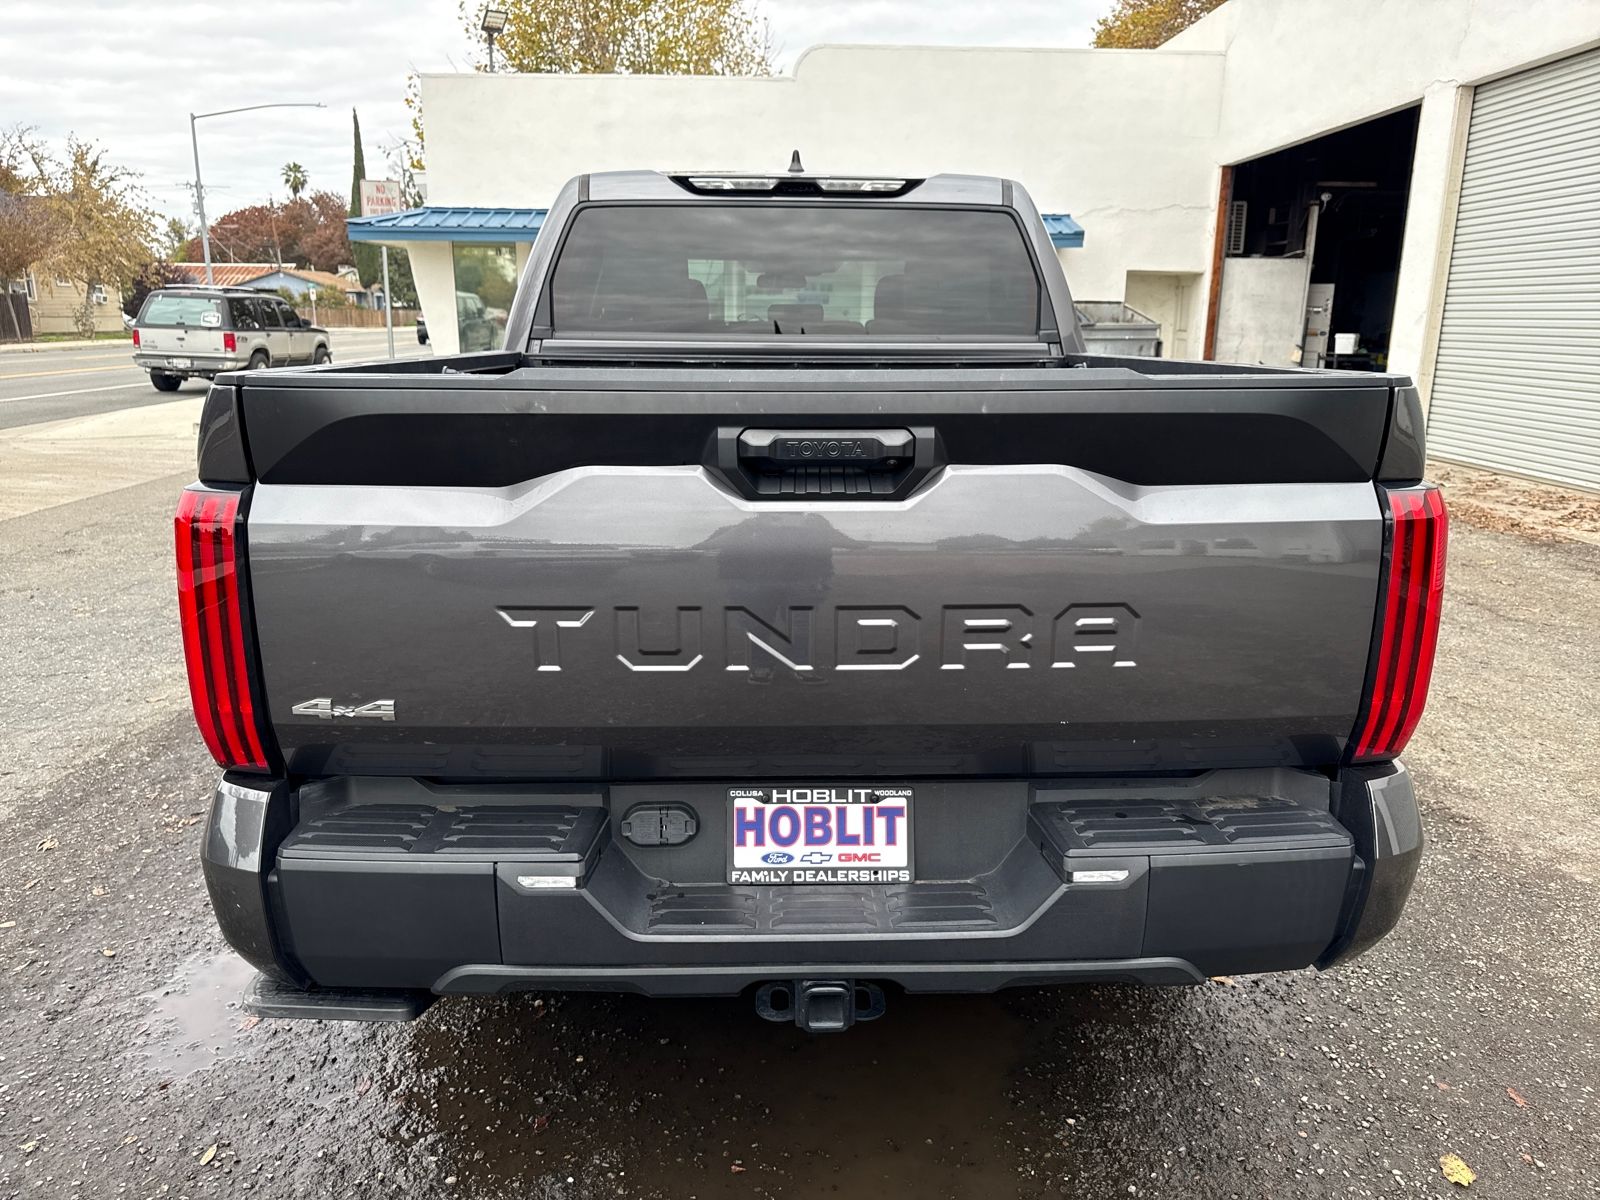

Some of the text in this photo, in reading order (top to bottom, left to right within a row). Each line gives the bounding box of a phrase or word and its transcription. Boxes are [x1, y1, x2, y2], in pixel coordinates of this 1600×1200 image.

[375, 183, 386, 194] NO
[786, 441, 867, 457] TOYOTA
[495, 602, 1141, 672] TUNDRA
[772, 789, 872, 803] HOBLIT
[735, 805, 905, 848] HOBLIT
[765, 852, 790, 865] Ford
[837, 853, 881, 863] GMC
[793, 870, 910, 882] DEALERSHIPS
